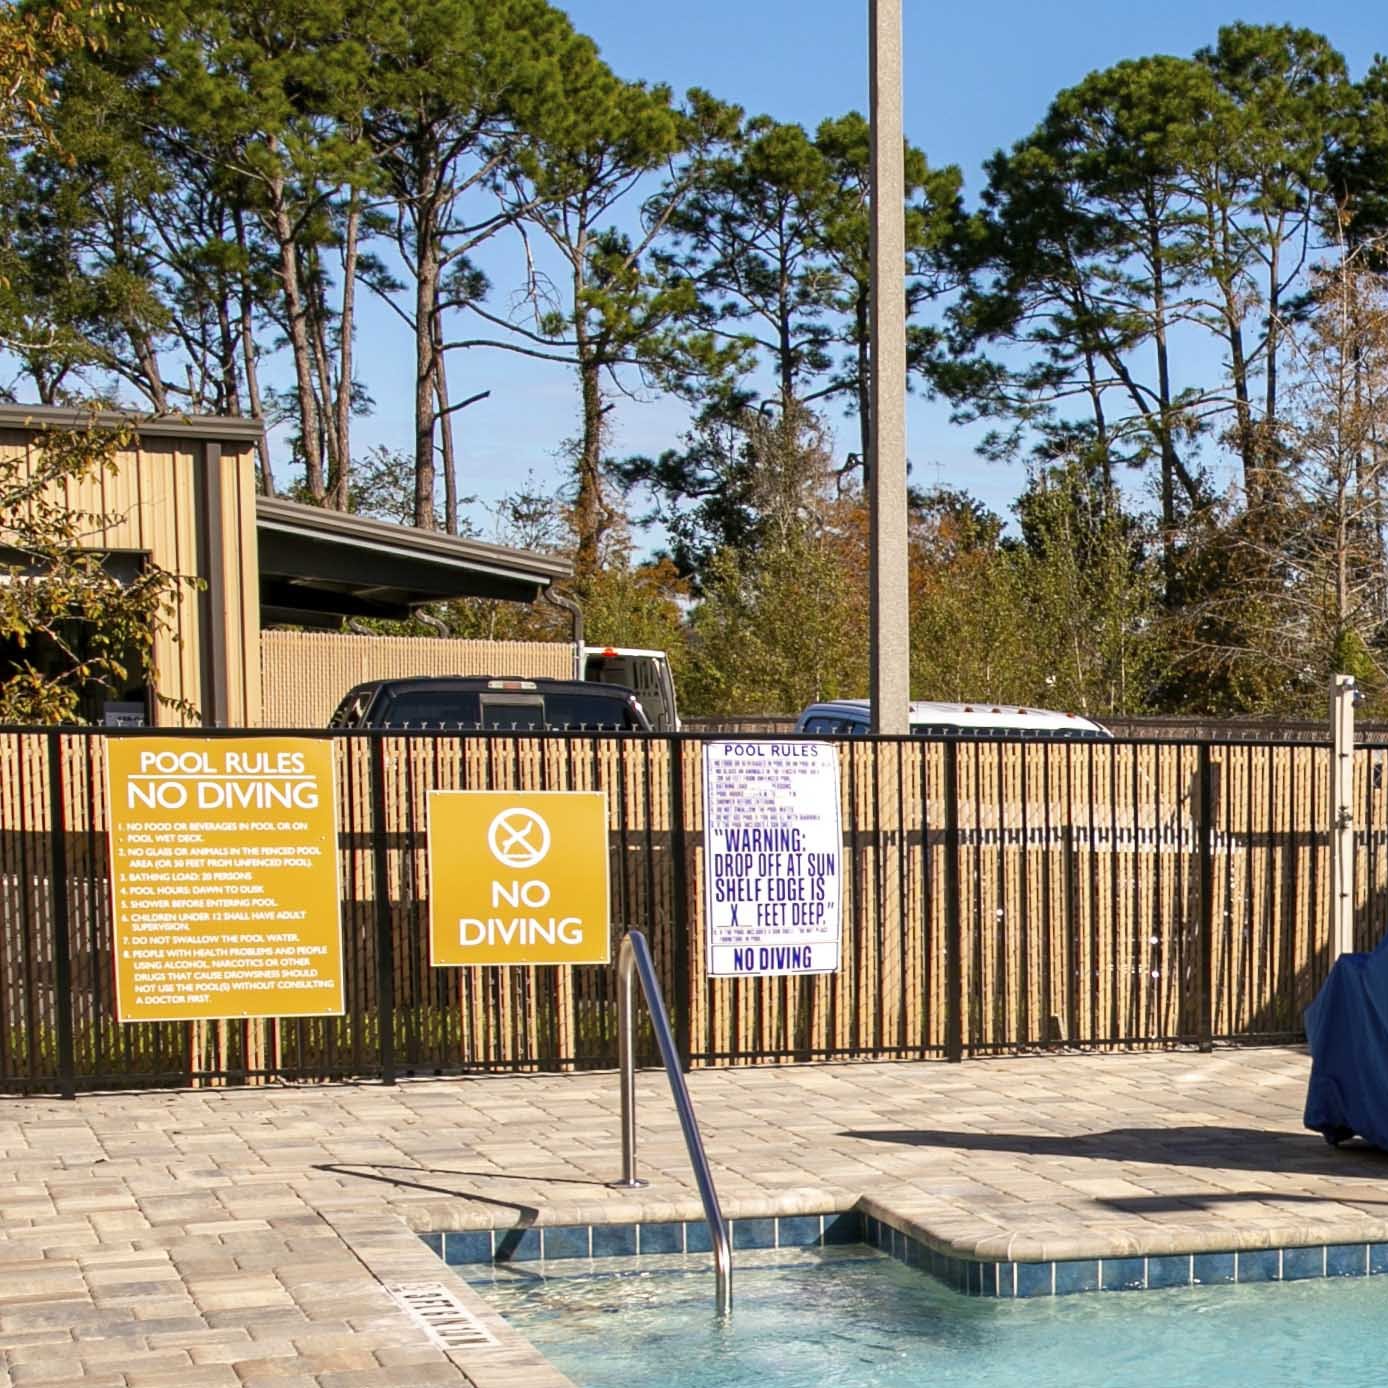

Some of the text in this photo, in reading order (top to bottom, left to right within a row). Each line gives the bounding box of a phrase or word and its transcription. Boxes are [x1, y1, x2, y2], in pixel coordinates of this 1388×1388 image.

[724, 744, 819, 758] POOL RULES
[140, 751, 305, 774] POOL RULES
[127, 781, 319, 809] NO DIVING
[126, 822, 143, 831] NO
[144, 822, 172, 831] FOOD
[173, 822, 188, 831] OR
[189, 822, 237, 831] BEVERAGES
[250, 822, 275, 831] POOL
[277, 822, 291, 831] OR
[127, 833, 153, 843] POOL
[154, 833, 175, 843] WET
[127, 847, 144, 857] NO
[145, 847, 172, 857] GLASS
[174, 847, 188, 857] OR
[190, 847, 228, 856] ANIMALS
[241, 846, 260, 856] THE
[261, 846, 295, 856] FENCED
[296, 846, 322, 856] POOL
[129, 859, 153, 868] AREA
[207, 858, 233, 868] FROM
[715, 852, 835, 877] DROP OFF AT SUN
[128, 872, 169, 882] BATHING
[129, 886, 155, 895] POOL
[191, 885, 224, 894] DAWN
[225, 885, 239, 894] TO
[491, 879, 551, 909] NO
[715, 877, 826, 902] SHELF EDGE IS
[130, 900, 170, 909] SHOWER
[206, 898, 249, 908] ENTERING
[130, 913, 177, 923] CHILDREN
[178, 913, 209, 922] UNDER
[223, 912, 250, 921] SHALL
[251, 911, 275, 921] HAVE
[276, 911, 306, 920] ADULT
[757, 903, 787, 926] FEET
[458, 917, 583, 947] DIVING
[131, 936, 148, 945] DO
[149, 935, 172, 945] NOT
[172, 934, 219, 944] SWALLOW
[221, 934, 239, 943] THE
[240, 933, 265, 943] POOL
[132, 949, 165, 959] PEOPLE
[166, 949, 192, 958] WITH
[193, 948, 228, 958] HEALTH
[274, 946, 296, 955] AND
[734, 946, 812, 971] NO DIVING
[134, 961, 162, 971] USING
[212, 958, 264, 969] NARCOTICS
[265, 958, 279, 968] OR
[280, 957, 310, 967] OTHER
[134, 972, 166, 982] DRUGS
[167, 971, 191, 981] THAT
[193, 971, 223, 981] CAUSE
[281, 968, 318, 978] SHOULD
[134, 984, 156, 993] NOT
[157, 983, 175, 993] USE
[175, 983, 193, 992] THE
[231, 980, 275, 991] WITHOUT
[144, 994, 186, 1004] DOCTOR
